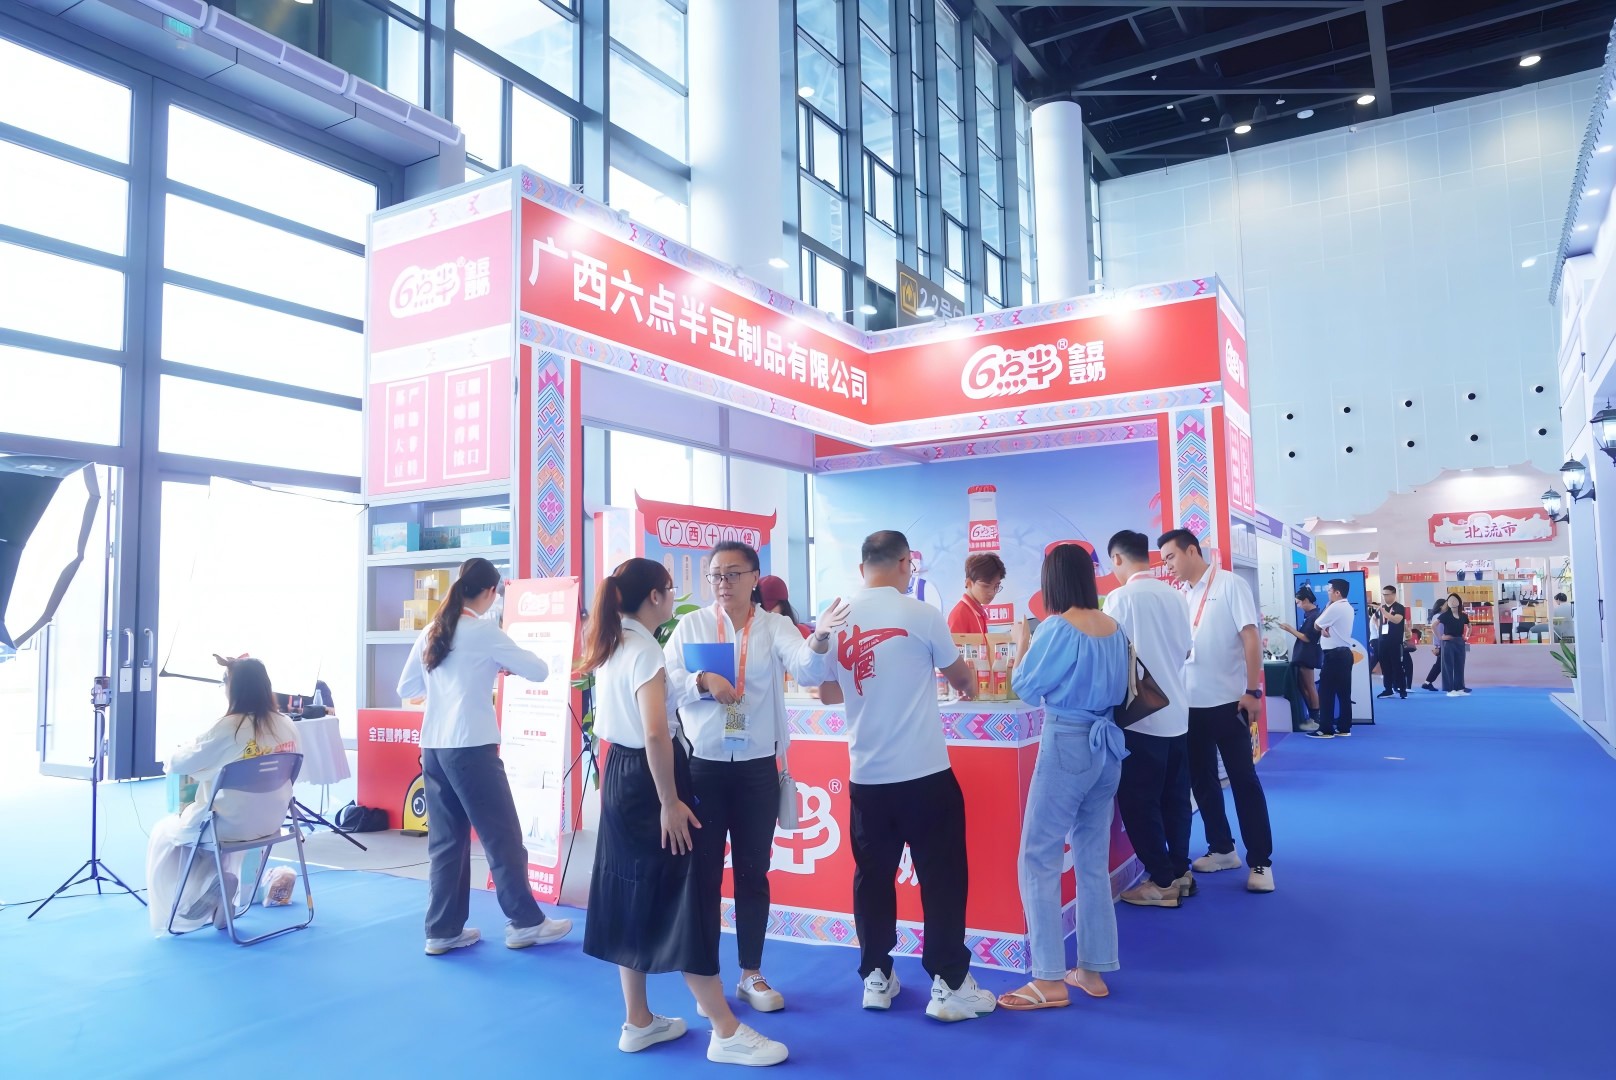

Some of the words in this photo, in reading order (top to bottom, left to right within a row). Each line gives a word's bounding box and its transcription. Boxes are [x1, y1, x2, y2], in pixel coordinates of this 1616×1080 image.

[529, 236, 868, 405] 广西六点半豆制品有限公司
[1465, 522, 1517, 539] 北流市
